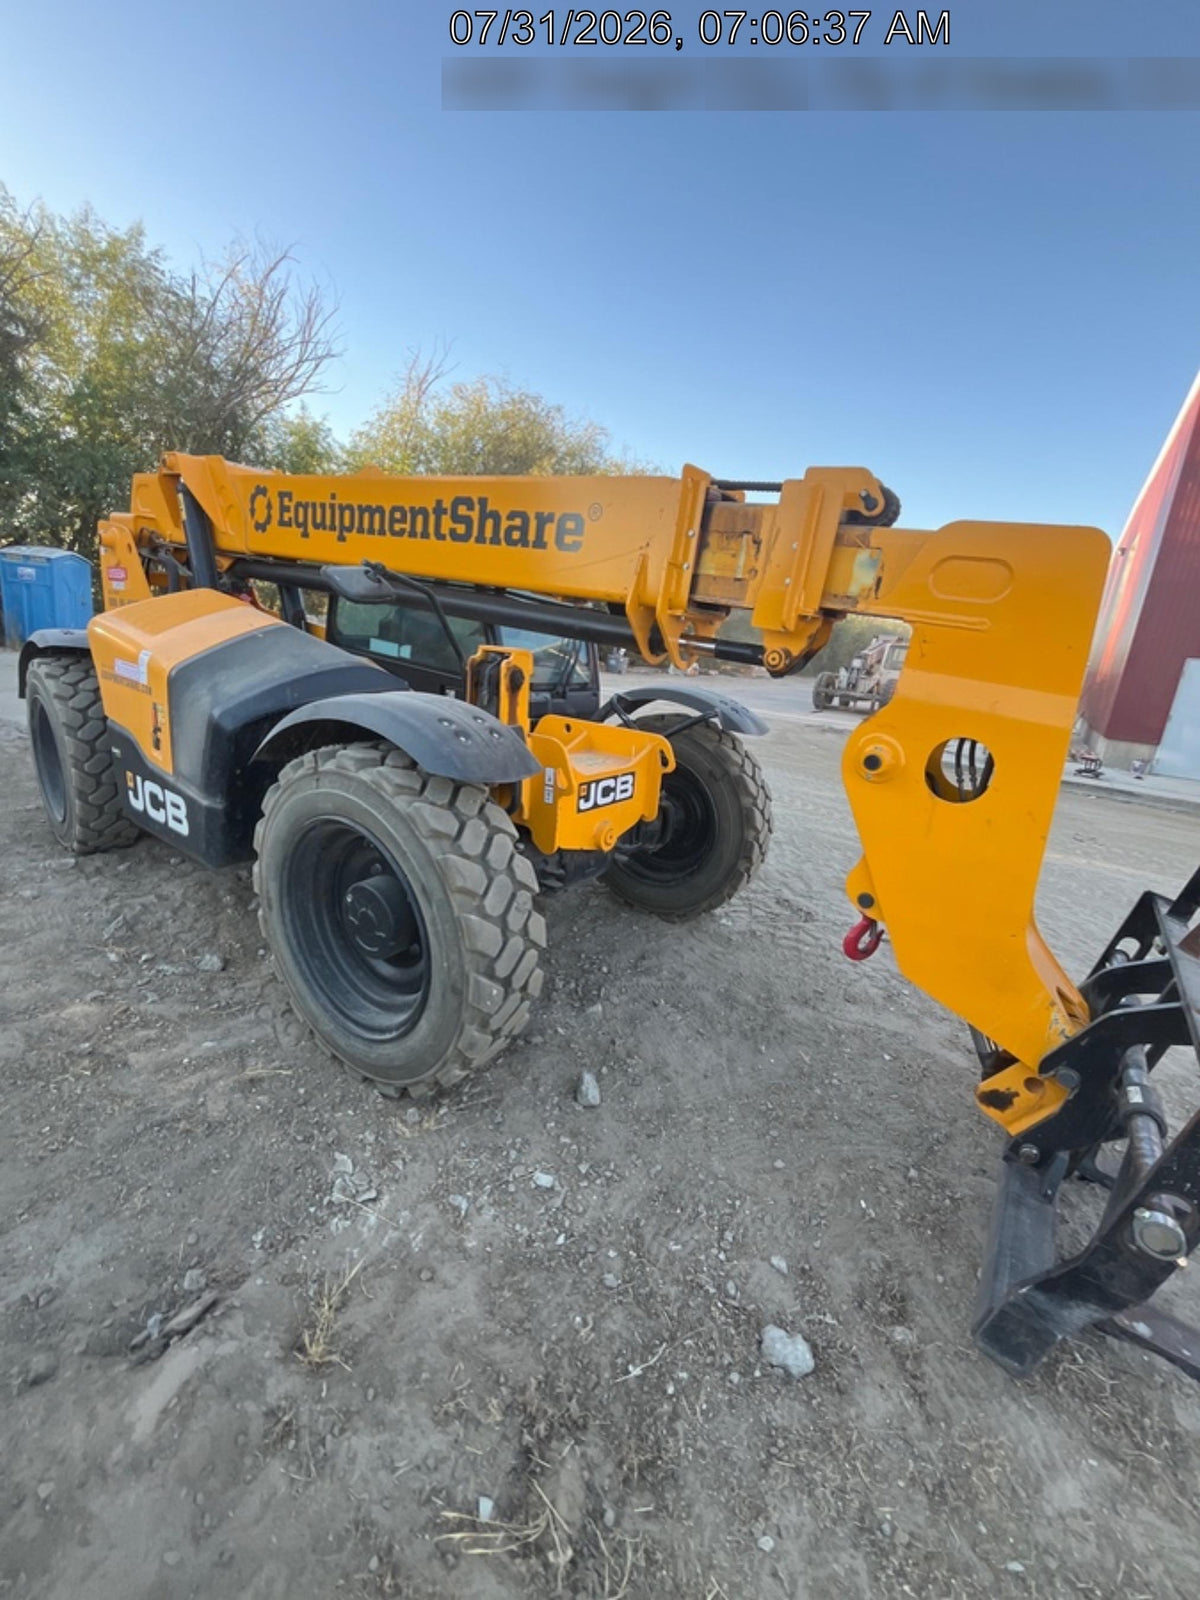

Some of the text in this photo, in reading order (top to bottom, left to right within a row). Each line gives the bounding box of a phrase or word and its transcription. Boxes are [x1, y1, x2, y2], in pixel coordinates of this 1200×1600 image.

[276, 490, 585, 553] EquipmentShare
[127, 774, 190, 837] JCB
[579, 774, 634, 811] JCB
